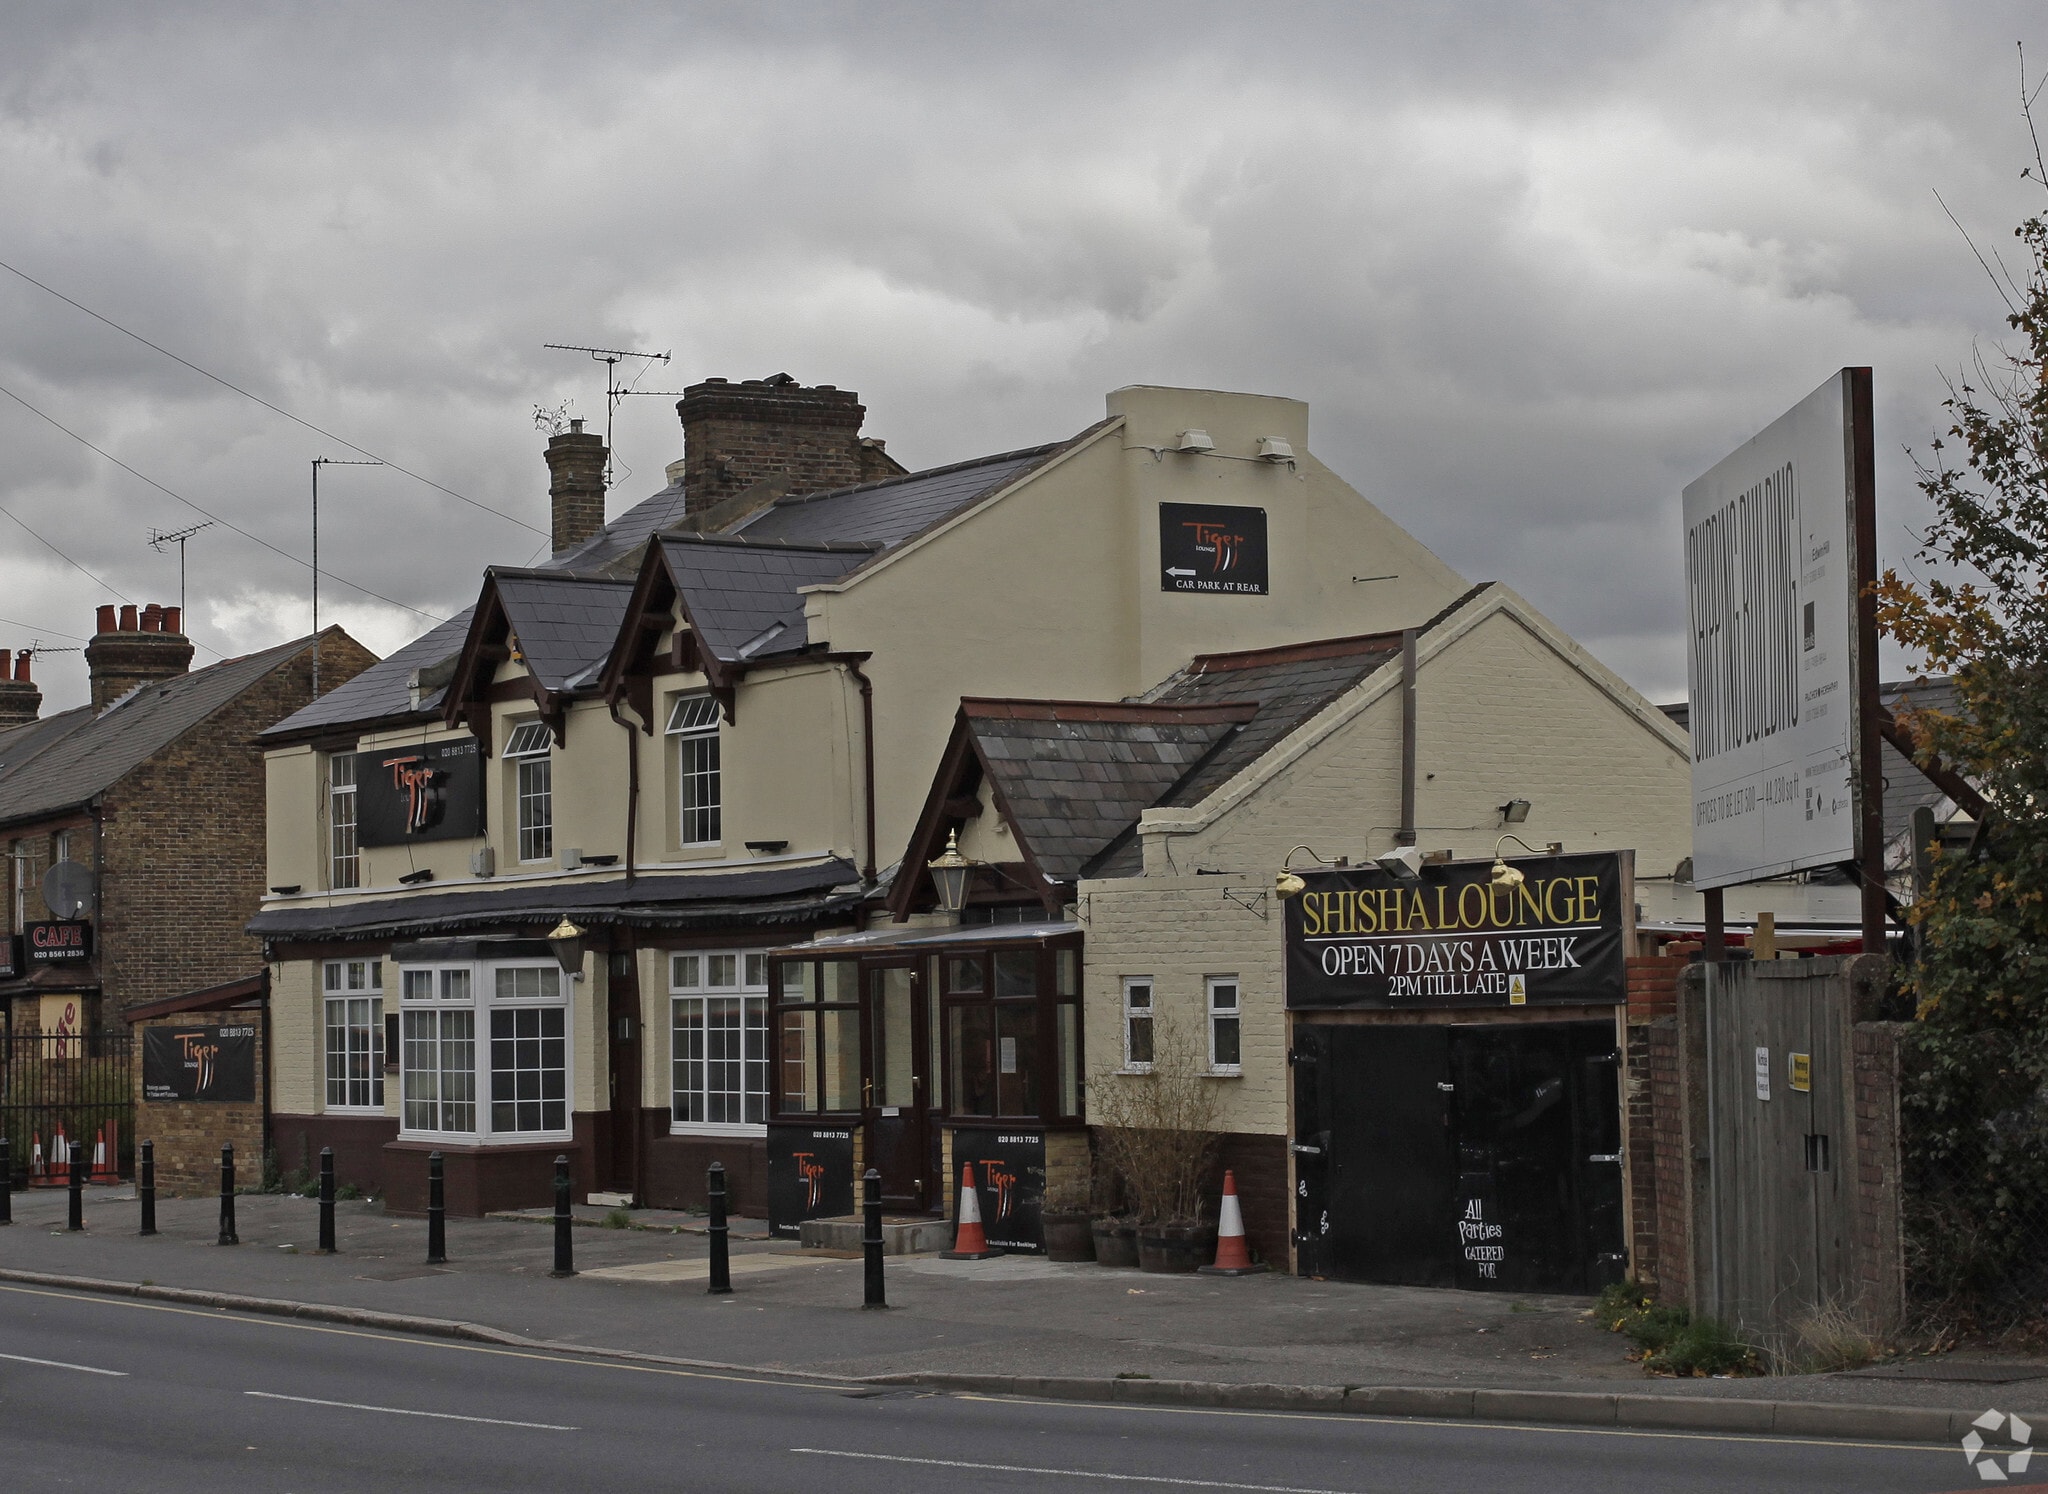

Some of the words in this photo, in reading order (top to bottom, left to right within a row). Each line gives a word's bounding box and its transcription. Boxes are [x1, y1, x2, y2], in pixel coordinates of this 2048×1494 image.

[1176, 580, 1195, 589] CAR
[1197, 580, 1221, 590] PARK
[1223, 582, 1235, 591] AT
[1237, 583, 1261, 592] REAR
[1740, 461, 1798, 744] BUILDING
[1696, 798, 1717, 827] OFFICES
[1718, 795, 1725, 820] TO
[1726, 793, 1733, 818] BE
[1734, 789, 1744, 815] LET
[1302, 887, 1433, 935] SHISHA
[1435, 876, 1602, 930] LOUNGE
[33, 925, 83, 948] CAFE
[34, 951, 47, 959] 020
[49, 950, 65, 958] 8561
[1321, 945, 1385, 976] OPEN
[1389, 944, 1402, 974] 7
[1406, 941, 1475, 974] DAYS
[1477, 940, 1498, 972] A
[1499, 936, 1582, 970] WEEK
[1388, 975, 1422, 996] 2PM
[1423, 974, 1461, 995] TILL
[1463, 973, 1507, 995] LATE
[219, 1028, 229, 1037] 020
[823, 1131, 835, 1139] 8813
[1465, 1199, 1482, 1220] All
[1458, 1220, 1502, 1245] Parties
[1465, 1246, 1505, 1261] CATERED
[1478, 1262, 1497, 1279] FOR
